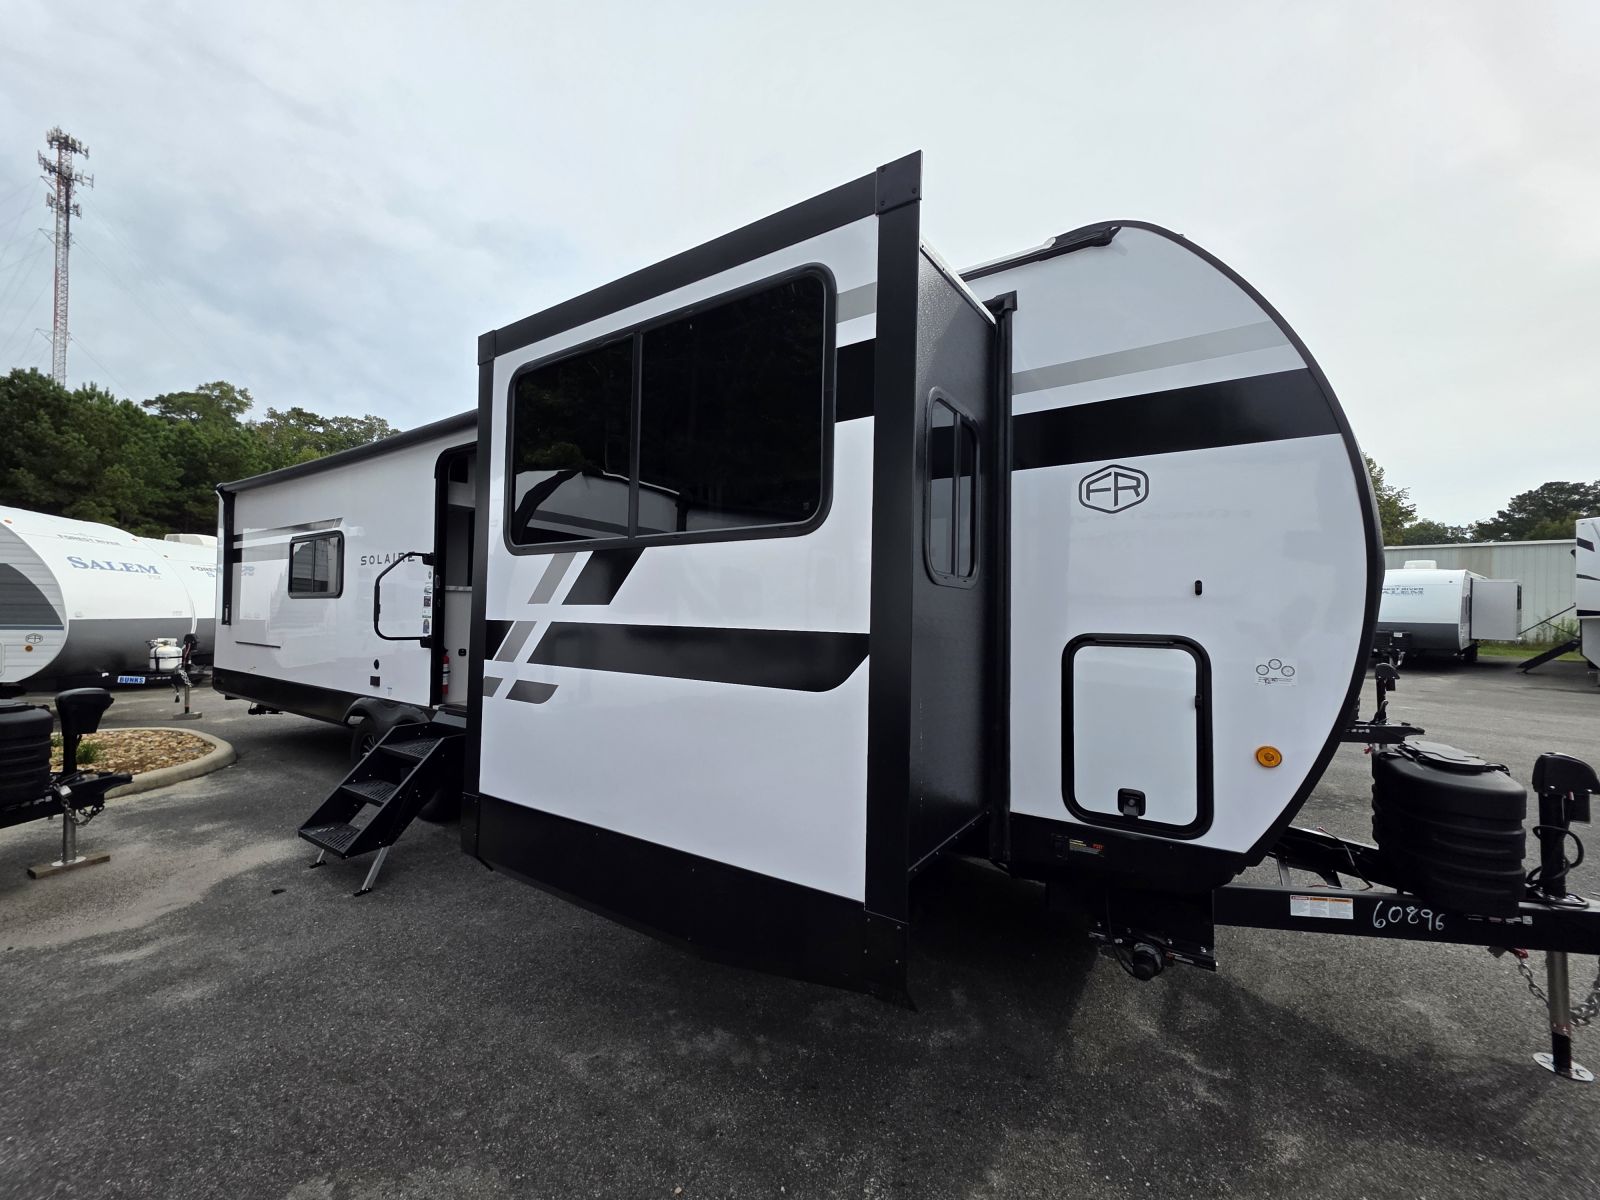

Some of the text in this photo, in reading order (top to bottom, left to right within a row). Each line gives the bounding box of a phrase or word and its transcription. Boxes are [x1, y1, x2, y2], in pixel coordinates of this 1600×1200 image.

[66, 555, 162, 575] SALEM
[119, 676, 144, 684] BUNKS
[1372, 900, 1447, 931] 60896
